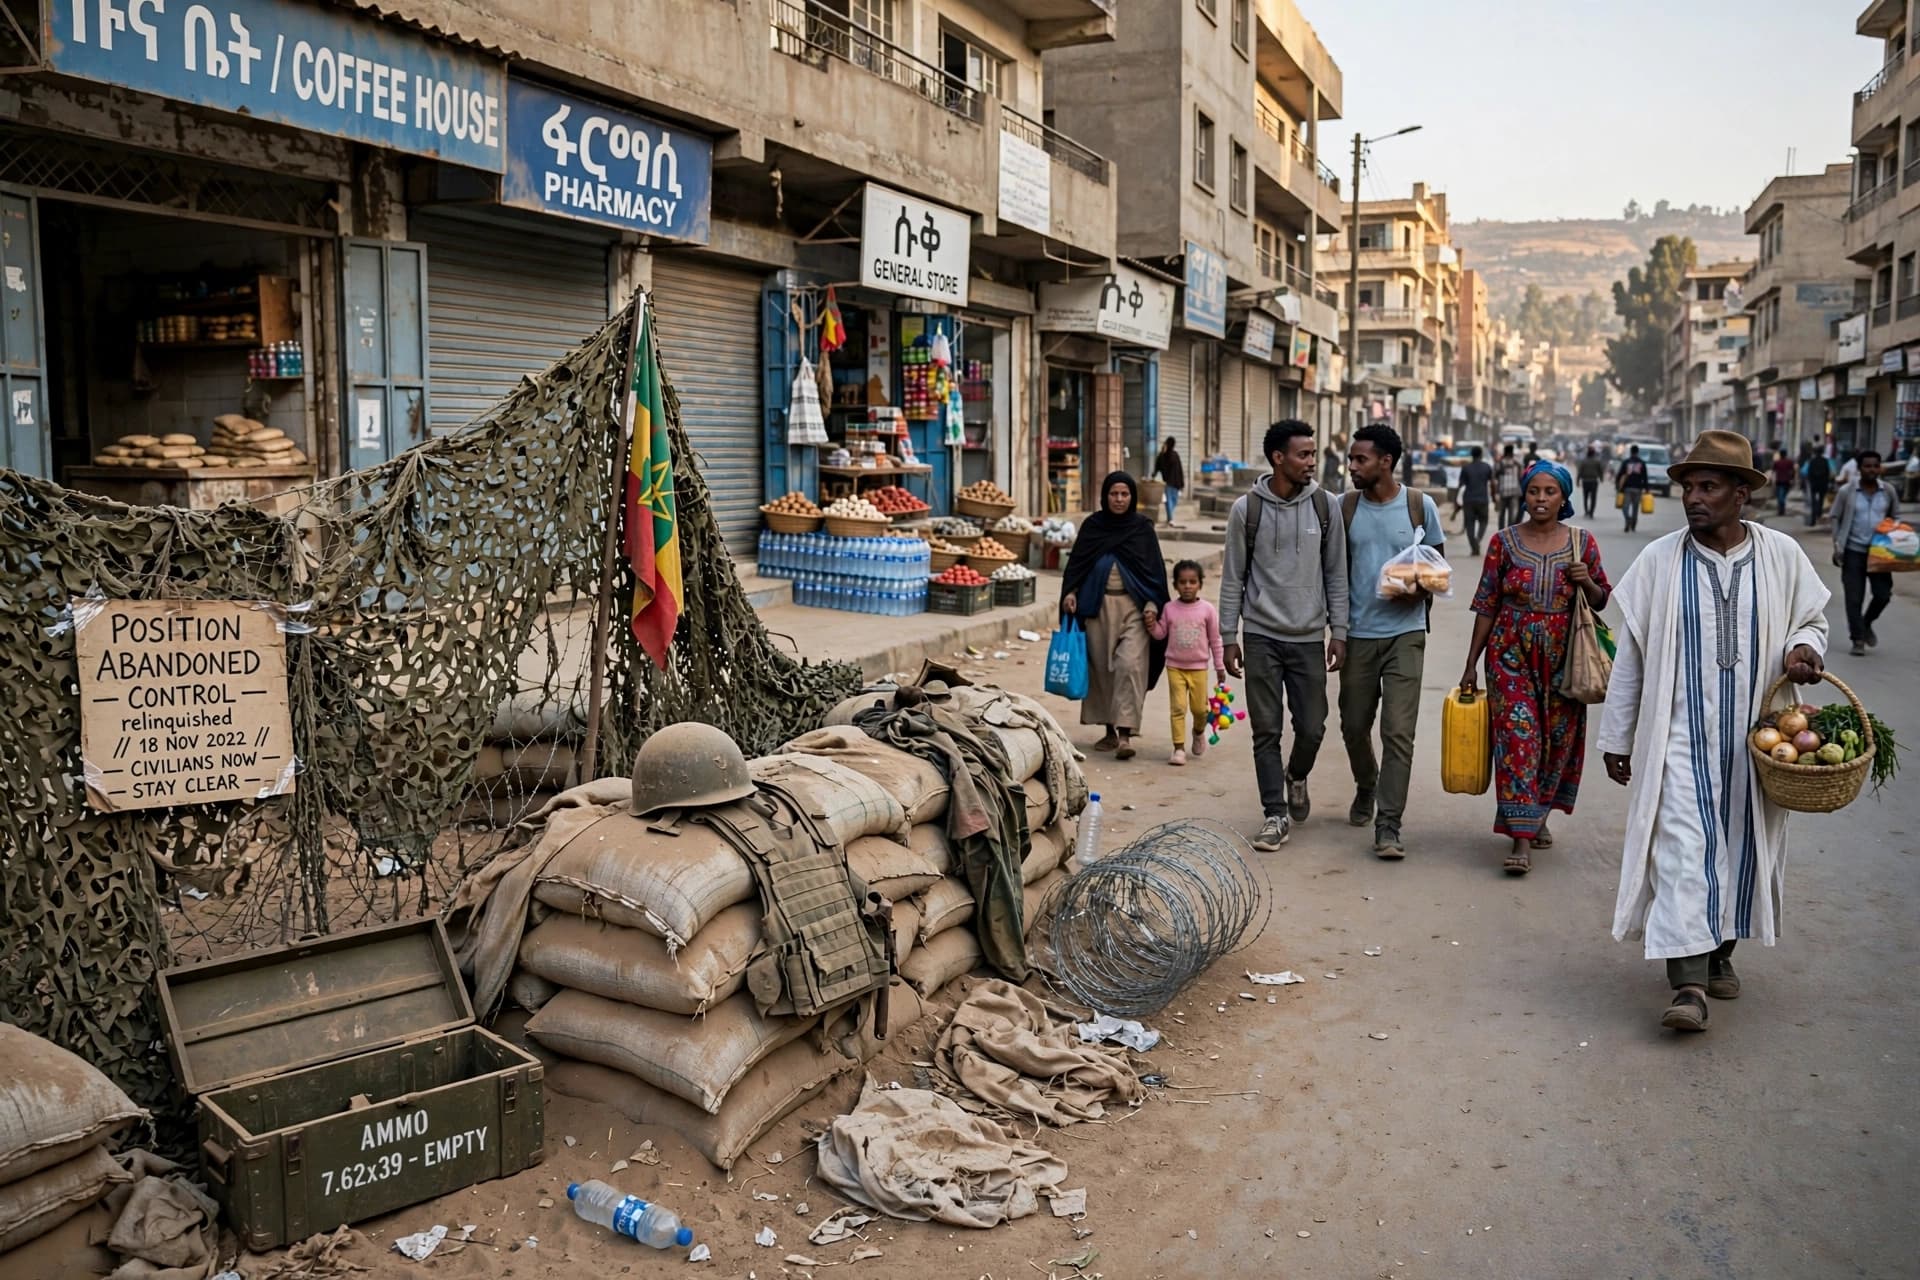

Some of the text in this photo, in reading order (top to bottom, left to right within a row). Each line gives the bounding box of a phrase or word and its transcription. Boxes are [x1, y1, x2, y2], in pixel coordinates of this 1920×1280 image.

[184, 4, 262, 85] ቤት
[292, 41, 407, 125] COFFEE
[415, 75, 499, 148] HOUSE
[542, 104, 683, 199] ፋርማሲ
[545, 171, 677, 228] PHARMACY
[894, 205, 941, 262] ሱቅ
[874, 258, 958, 295] GENERAL STORE
[111, 613, 241, 644] POSITION
[96, 649, 261, 681] ABANDONED
[128, 683, 237, 709] CONTROL
[121, 707, 232, 735] relinquished
[139, 738, 158, 753] 18
[166, 735, 199, 751] NOV
[206, 731, 247, 747] 2022
[131, 751, 257, 776] CIVILIANS NOW
[132, 774, 240, 799] STAY CLEAR
[360, 1109, 429, 1151] AMMO
[321, 1152, 403, 1196] 7.62x39
[425, 1126, 488, 1167] EMPTY
